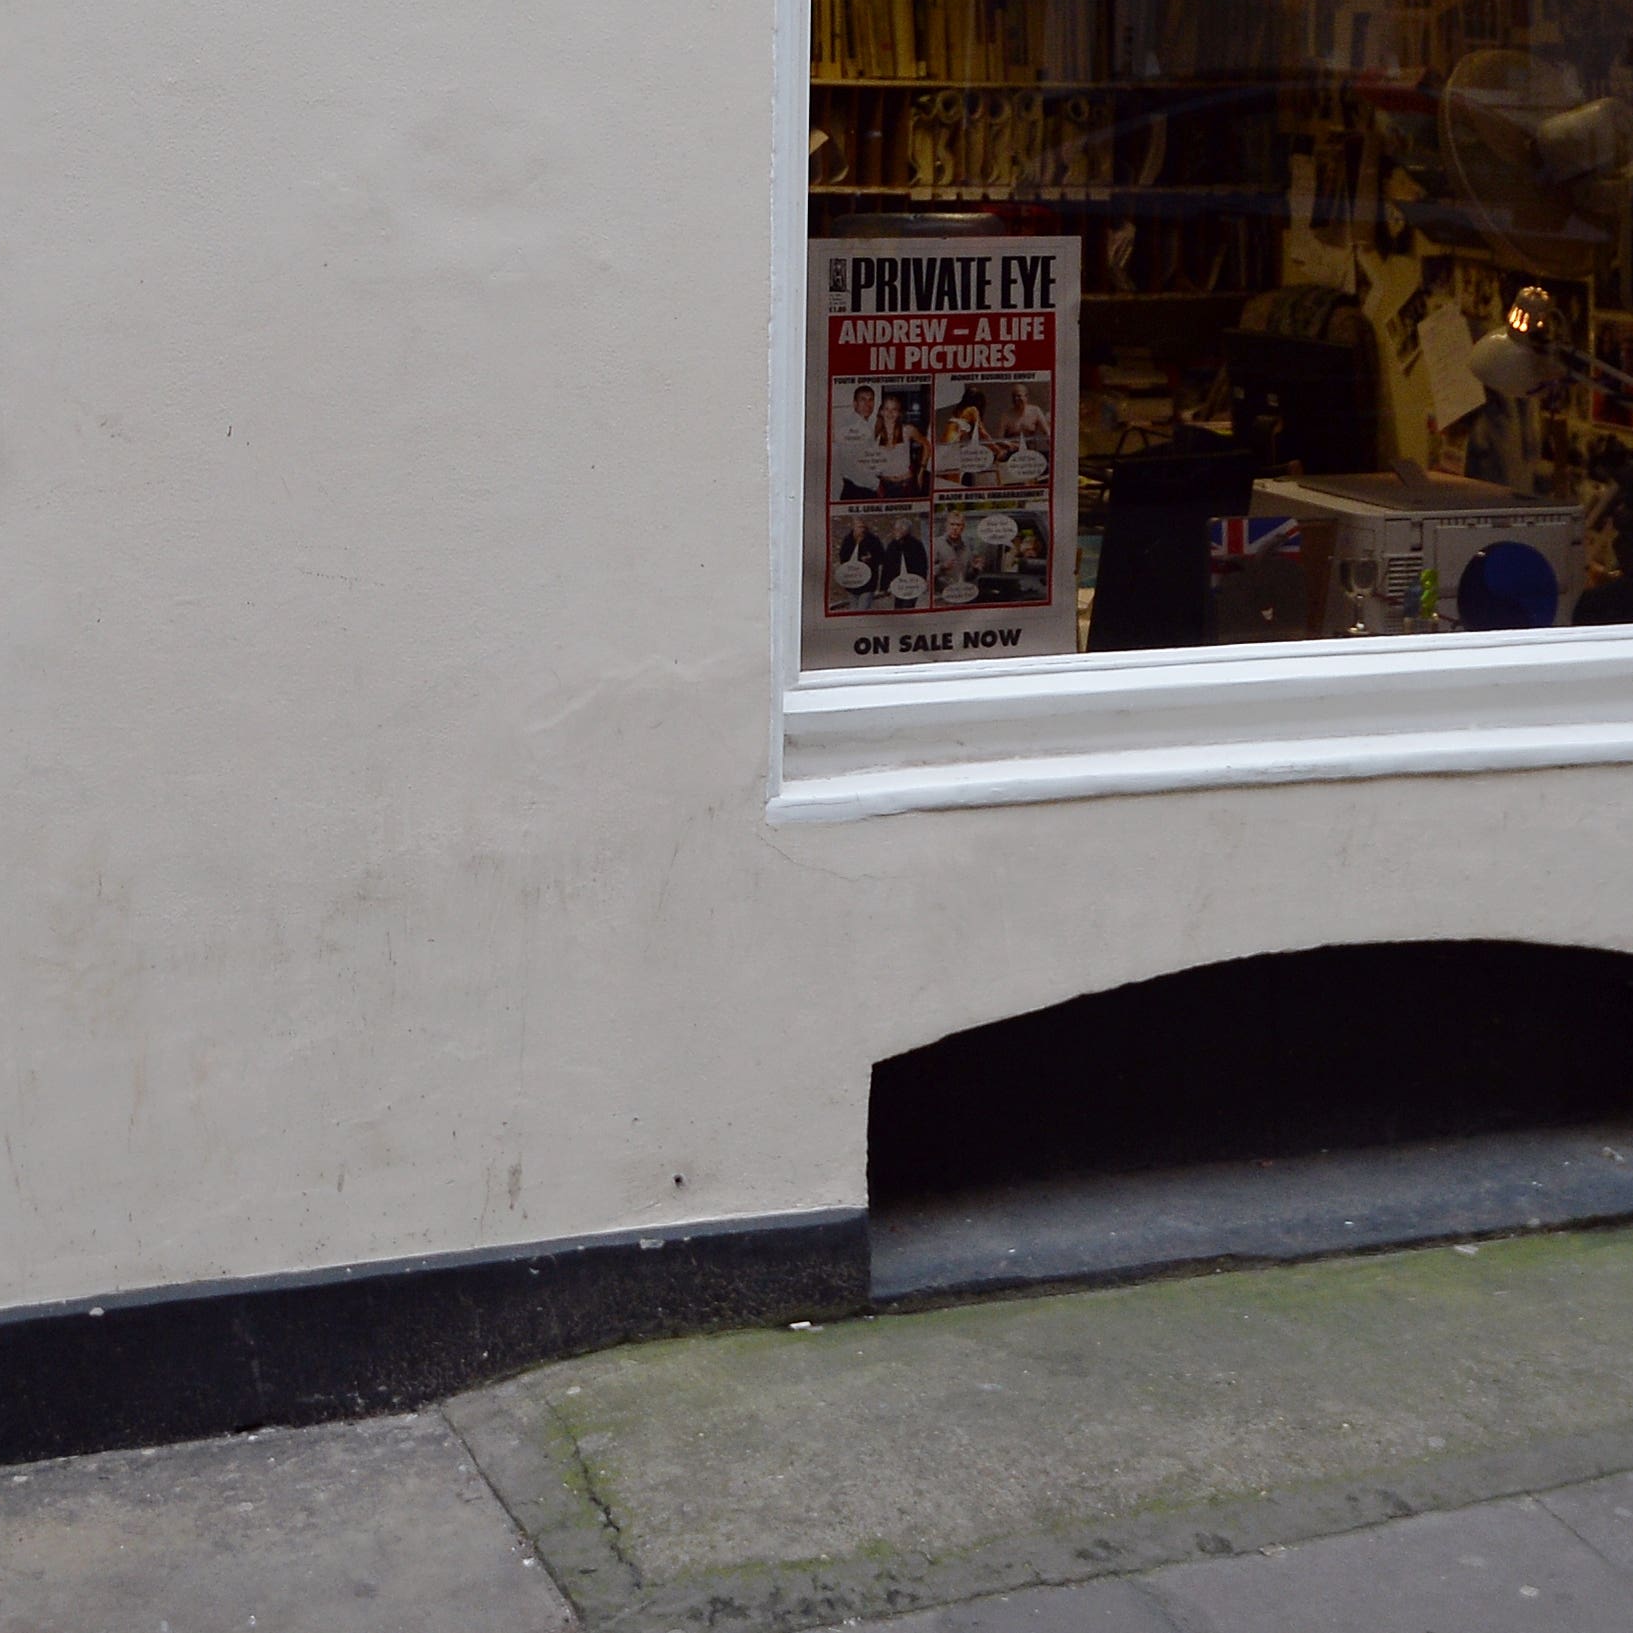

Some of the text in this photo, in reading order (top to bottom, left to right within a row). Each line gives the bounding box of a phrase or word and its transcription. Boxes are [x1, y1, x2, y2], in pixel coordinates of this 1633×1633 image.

[851, 255, 1057, 313] PRIVATE EYE
[838, 318, 948, 345] ANDREW
[974, 317, 992, 342] A
[999, 316, 1046, 342] LIFE
[869, 343, 1017, 371] IN PICTURES
[854, 628, 1022, 655] ON SALE NOW
